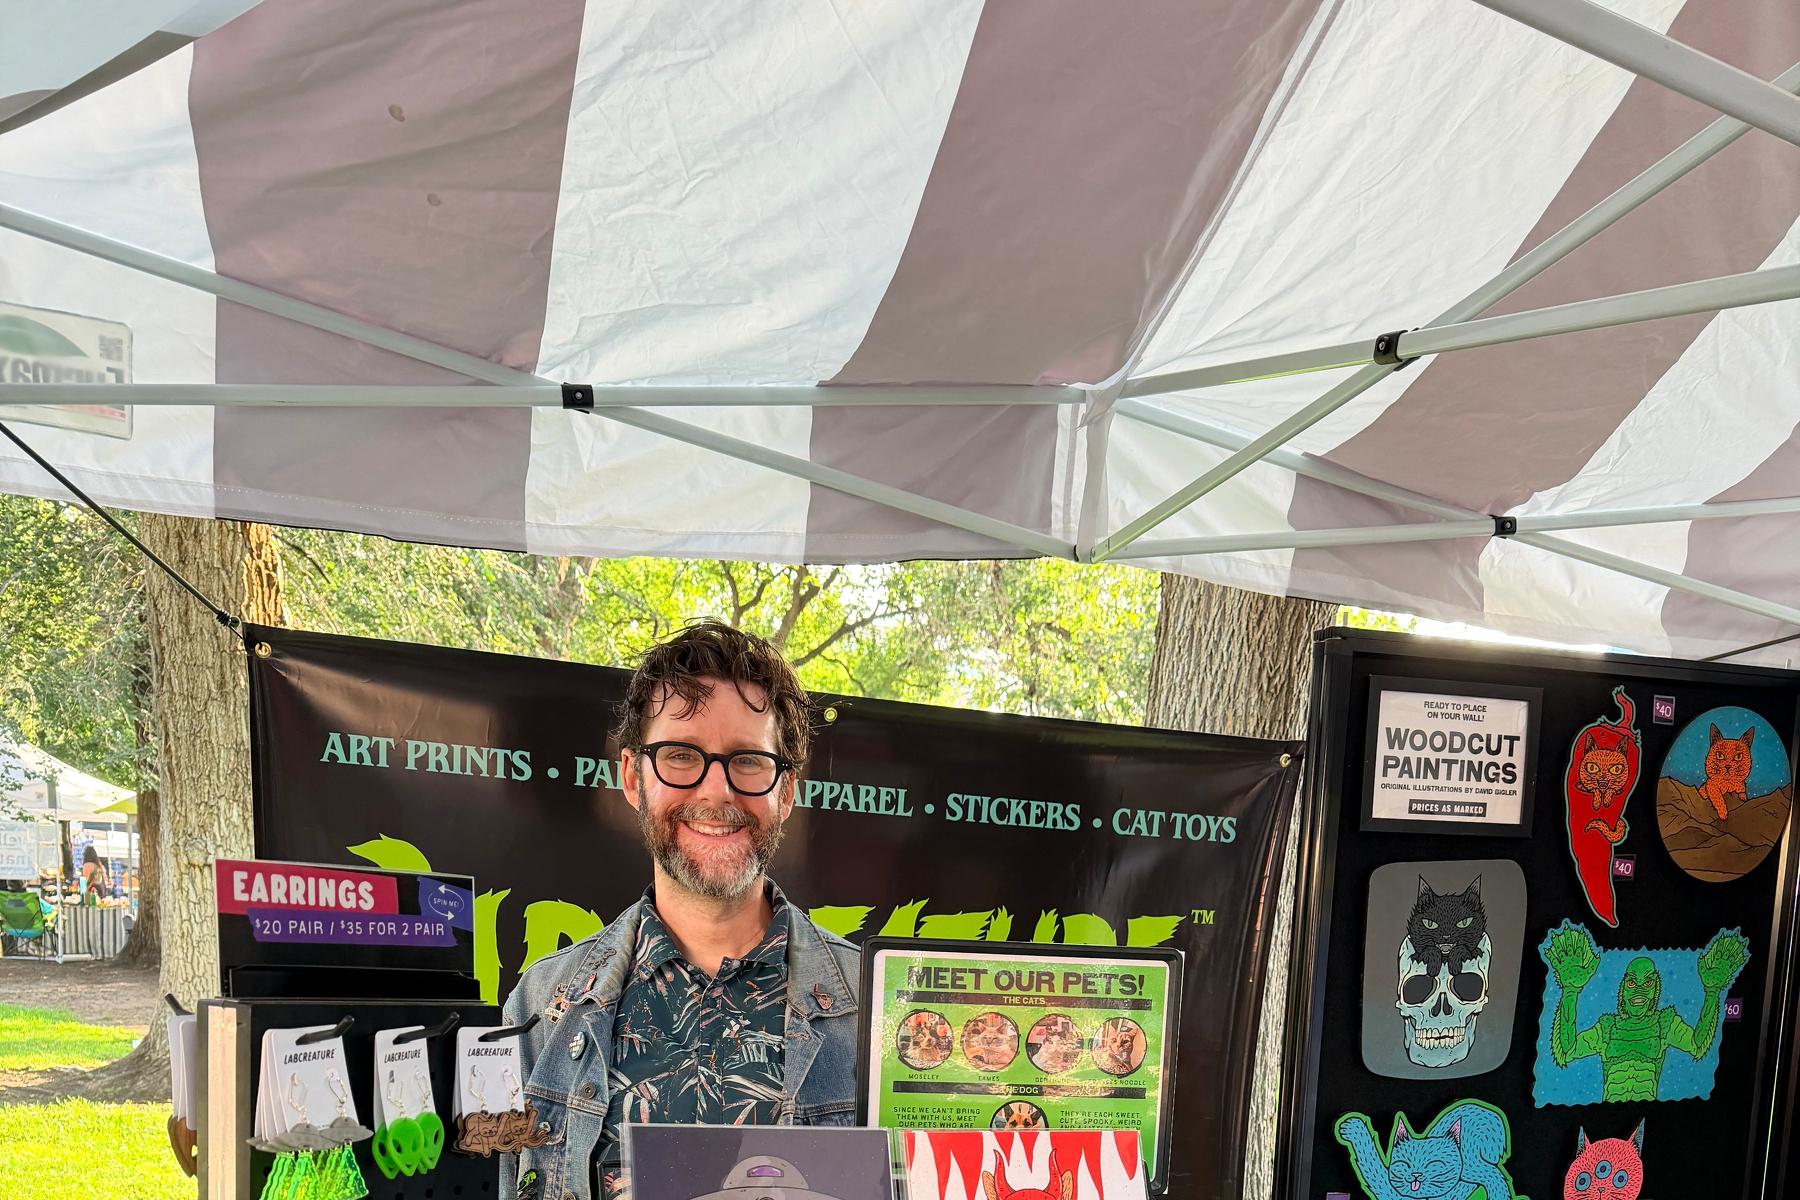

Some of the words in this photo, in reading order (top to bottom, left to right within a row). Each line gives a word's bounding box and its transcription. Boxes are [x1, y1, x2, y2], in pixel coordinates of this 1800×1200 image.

[1424, 701, 1450, 710] READY
[1451, 703, 1461, 711] TO
[1463, 704, 1487, 713] PLACE
[1656, 702, 1672, 717] $40
[1440, 712, 1460, 721] YOUR
[1462, 714, 1484, 722] WALL!
[1385, 727, 1521, 757] WOODCUT
[1382, 755, 1518, 785] PAINTINGS
[320, 732, 396, 768] ART
[404, 740, 533, 781] PRINTS
[945, 793, 1081, 831] STICKERS
[1112, 808, 1165, 837] CAT
[1170, 812, 1238, 843] TOYS
[1380, 783, 1411, 791] ORIGINAL
[1413, 784, 1463, 793] ILLUSTRATIONS
[1412, 803, 1439, 812] PRICES
[1441, 804, 1451, 812] AS
[1454, 805, 1484, 814] MARKED
[1614, 861, 1632, 875] $40
[233, 870, 375, 911] EARRINGS
[433, 897, 448, 905] SPIN
[1191, 909, 1215, 925] TM
[255, 918, 282, 935] $20
[288, 920, 324, 935] PAIR
[330, 921, 334, 935] /
[340, 919, 363, 935] $35
[369, 922, 396, 935] FOR
[402, 922, 409, 936] 2
[415, 923, 445, 936] PAIR
[907, 966, 988, 990] MEET
[994, 970, 1055, 993] OUR
[1062, 972, 1145, 996] PETS!
[1003, 996, 1019, 1004] THE
[1021, 997, 1046, 1005] CATS
[284, 1048, 336, 1065] LABCREATURE
[384, 1049, 421, 1064] LABCREATURE
[467, 1047, 513, 1058] LABCREATURE
[1020, 1086, 1039, 1094] DOG
